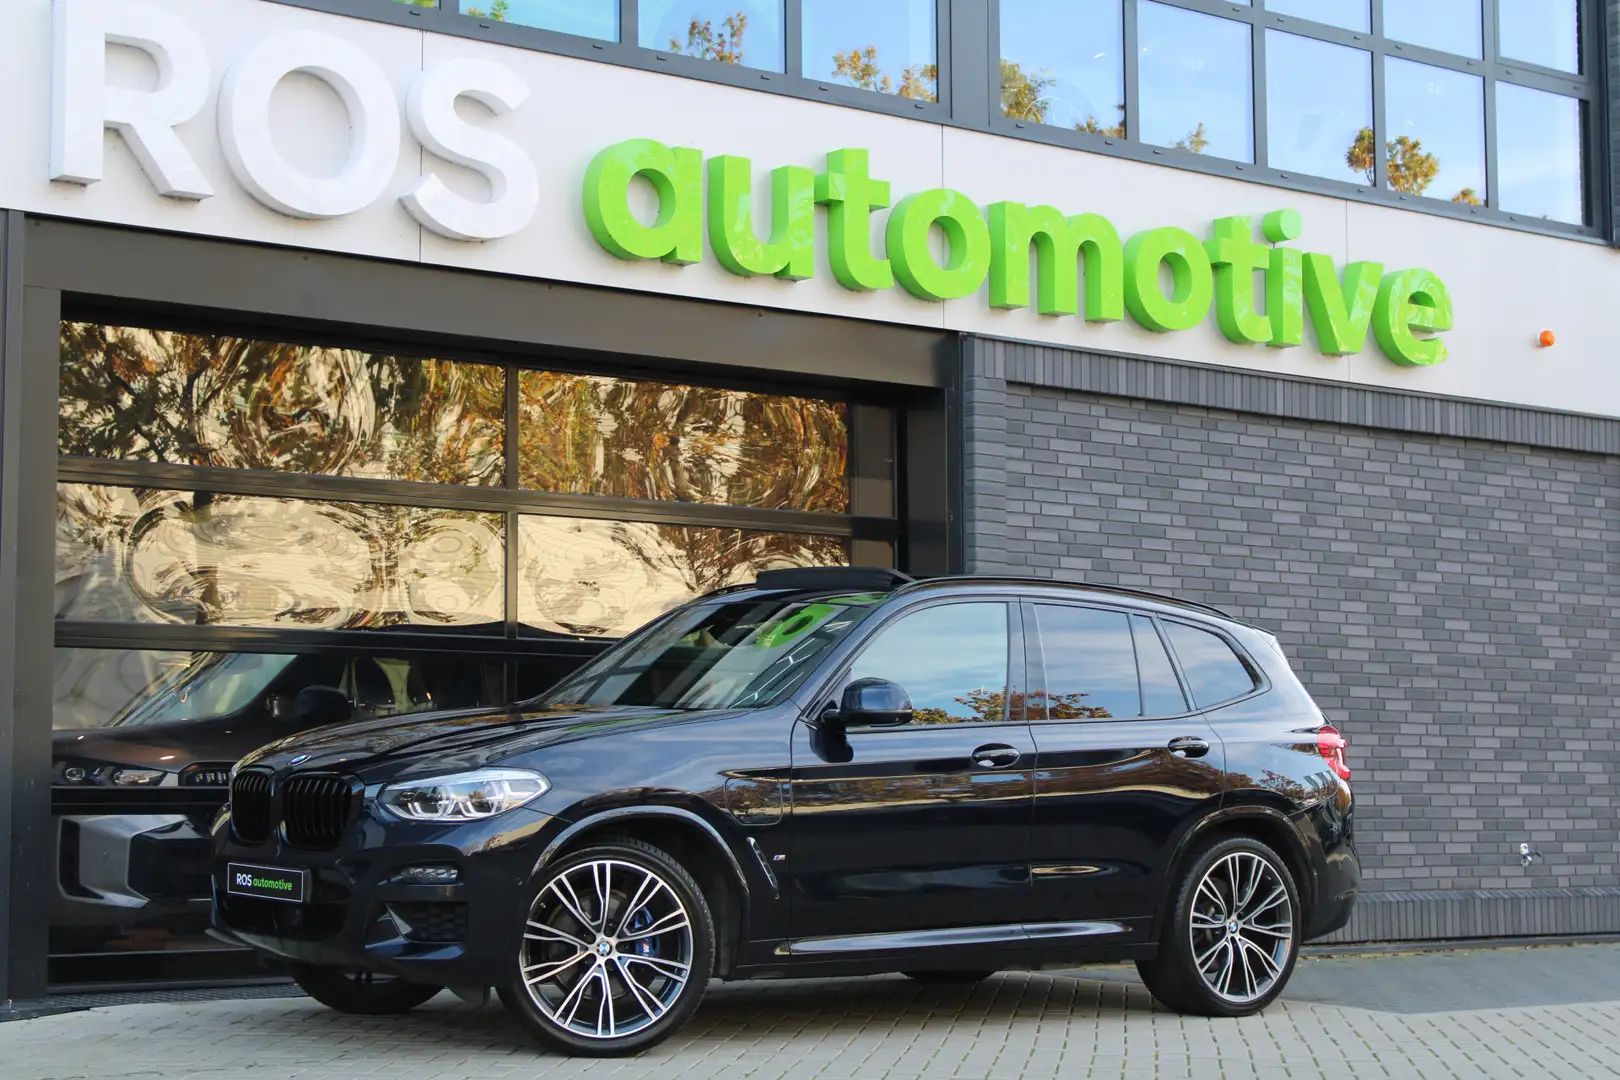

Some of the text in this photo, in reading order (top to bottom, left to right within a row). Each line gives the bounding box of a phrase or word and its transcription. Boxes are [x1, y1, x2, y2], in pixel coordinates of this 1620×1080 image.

[50, 0, 1453, 366] ROS automotive
[236, 873, 292, 890] ROS automotive
